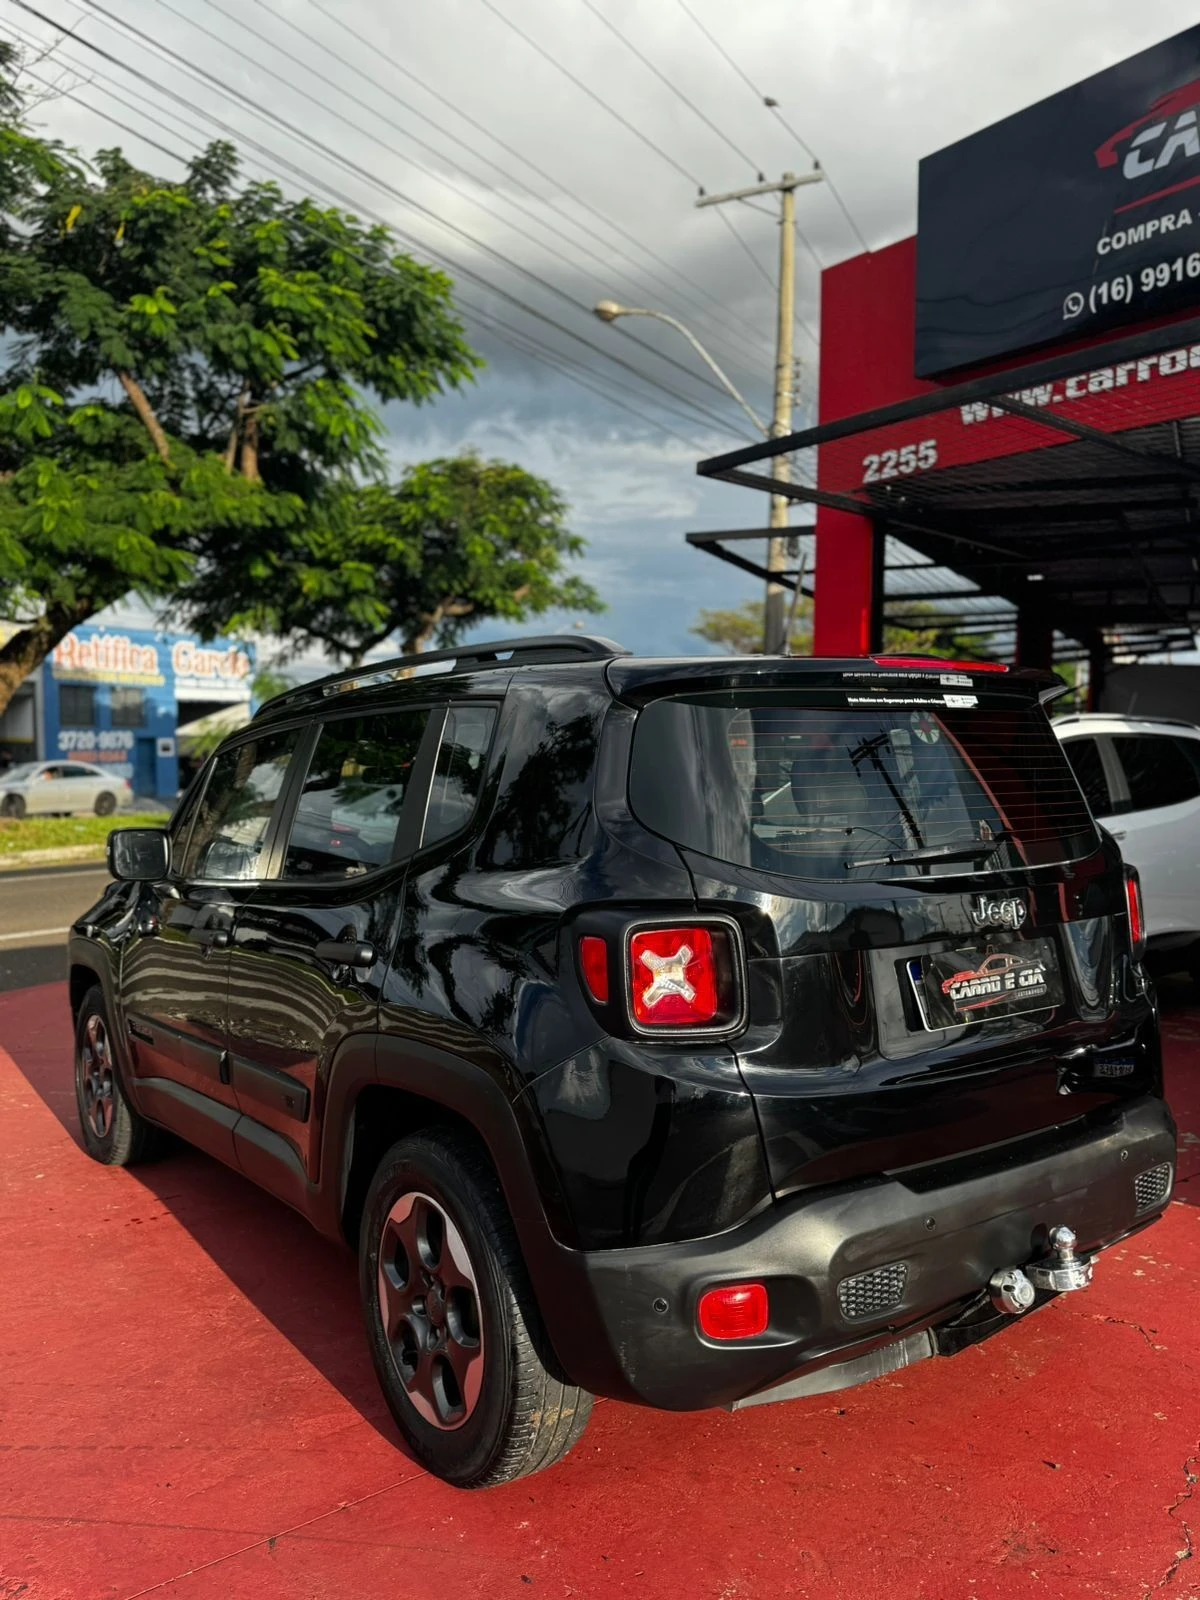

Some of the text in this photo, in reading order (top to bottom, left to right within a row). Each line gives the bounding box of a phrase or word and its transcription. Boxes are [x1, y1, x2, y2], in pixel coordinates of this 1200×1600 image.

[1097, 208, 1193, 255] COMPRA
[1089, 252, 1200, 313] (16) 9916
[862, 438, 938, 484] 2255
[971, 896, 1027, 930] Jeep
[1004, 972, 1016, 990] E
